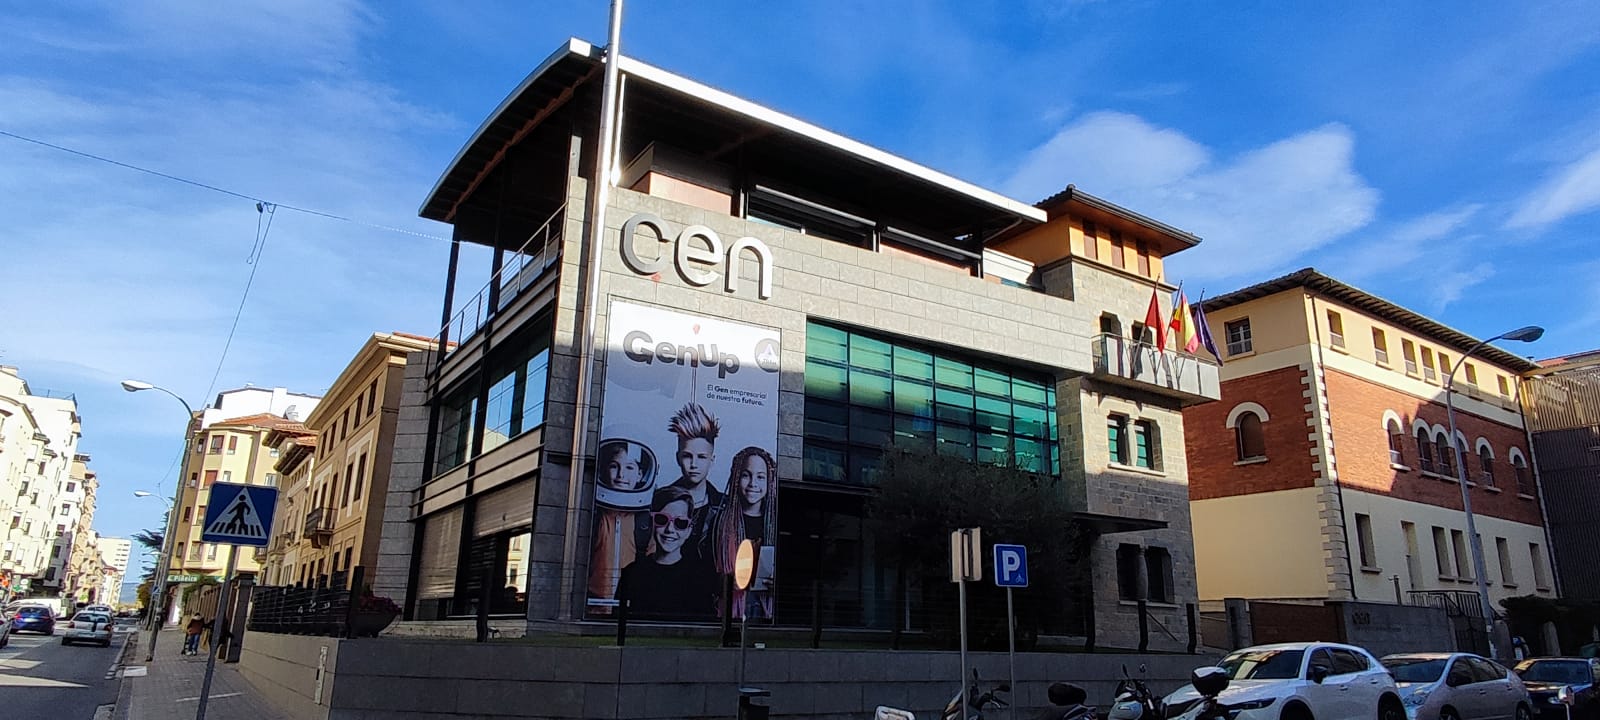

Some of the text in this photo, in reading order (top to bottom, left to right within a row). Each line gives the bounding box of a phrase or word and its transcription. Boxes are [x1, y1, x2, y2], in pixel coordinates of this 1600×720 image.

[623, 330, 740, 379] GenUp
[729, 389, 767, 399] empresarial
[1002, 550, 1021, 581] P
